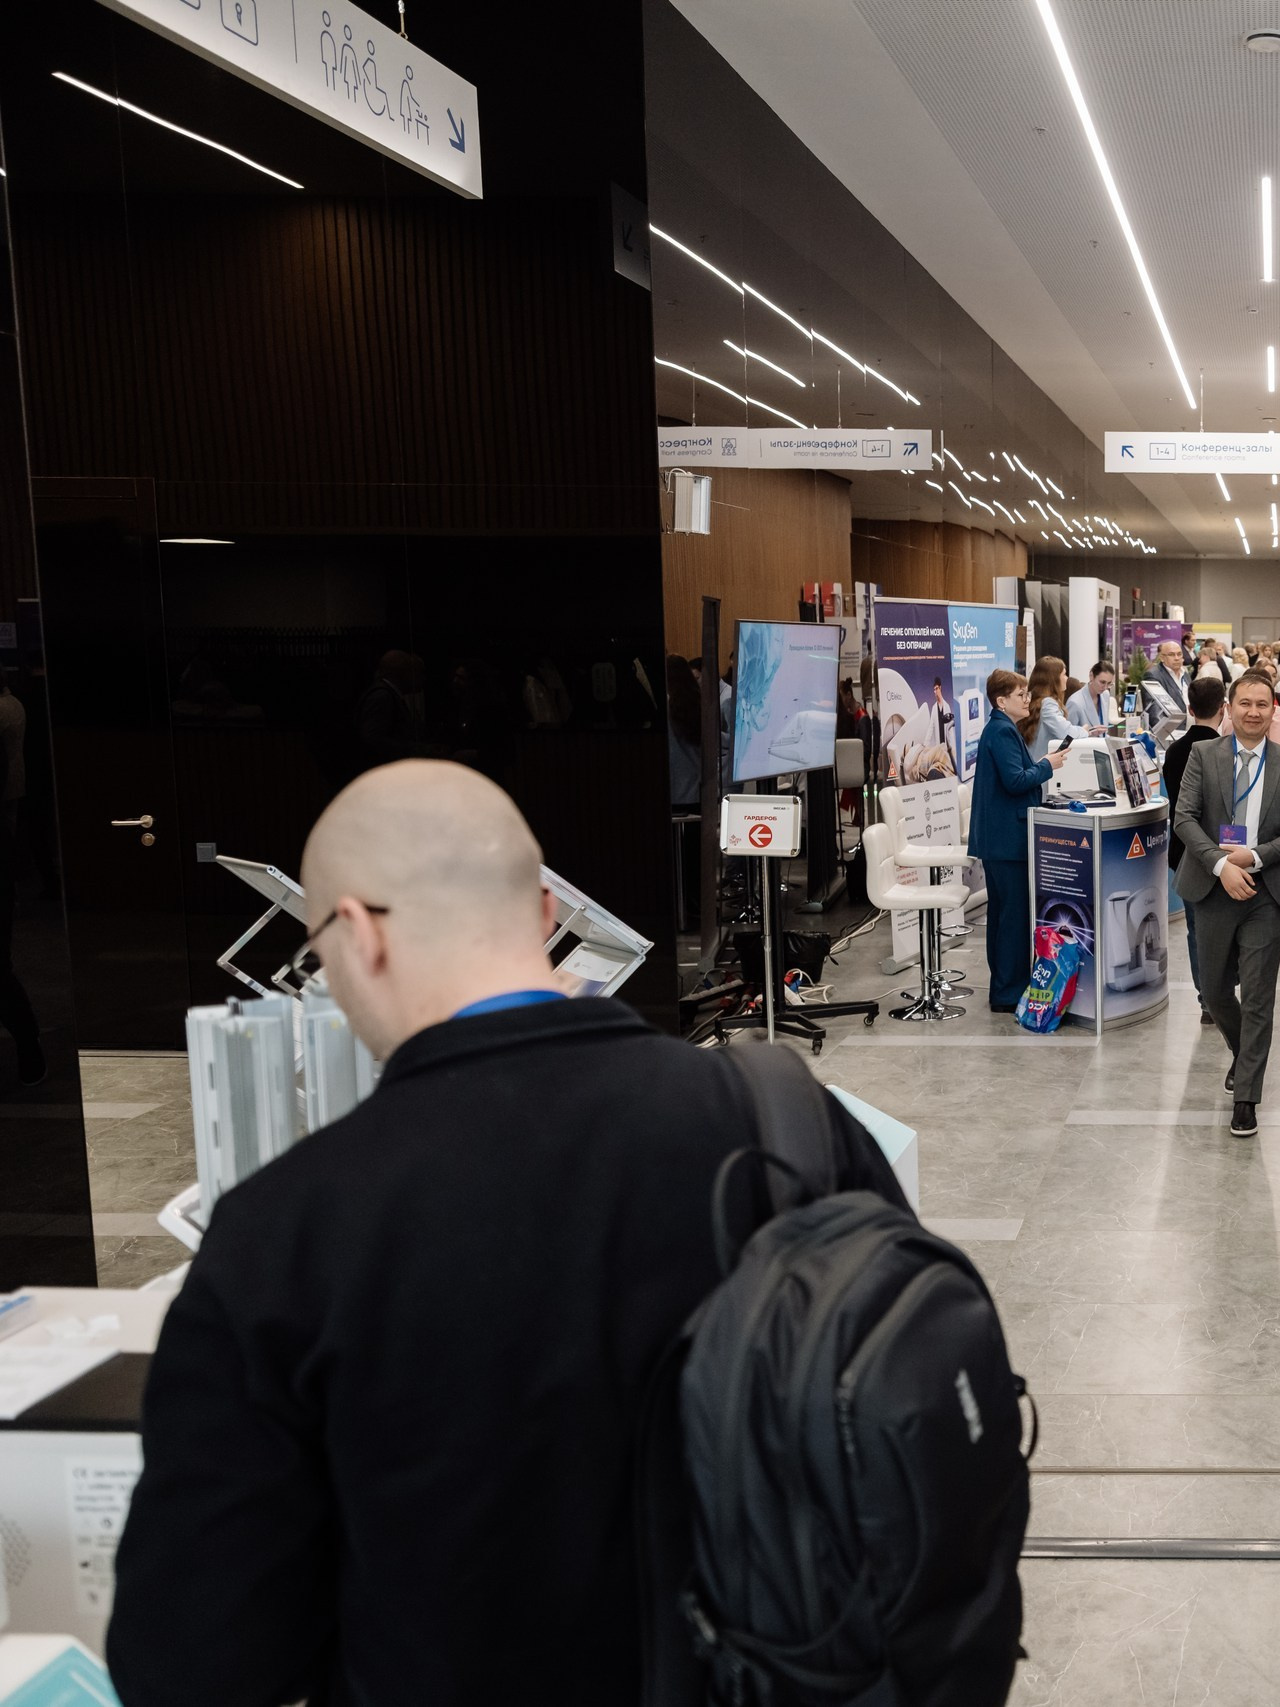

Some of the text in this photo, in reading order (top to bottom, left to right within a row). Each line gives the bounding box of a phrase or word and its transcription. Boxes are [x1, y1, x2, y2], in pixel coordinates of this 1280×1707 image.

[1156, 447, 1170, 455] 1-4
[1181, 443, 1273, 453] Конференц-залы
[880, 626, 945, 637] ЛЕЧЕНИЕ ОПУХОЛЕЙ МОЗГА
[896, 641, 933, 650] БЕЗ ОПЕРАЦИИ
